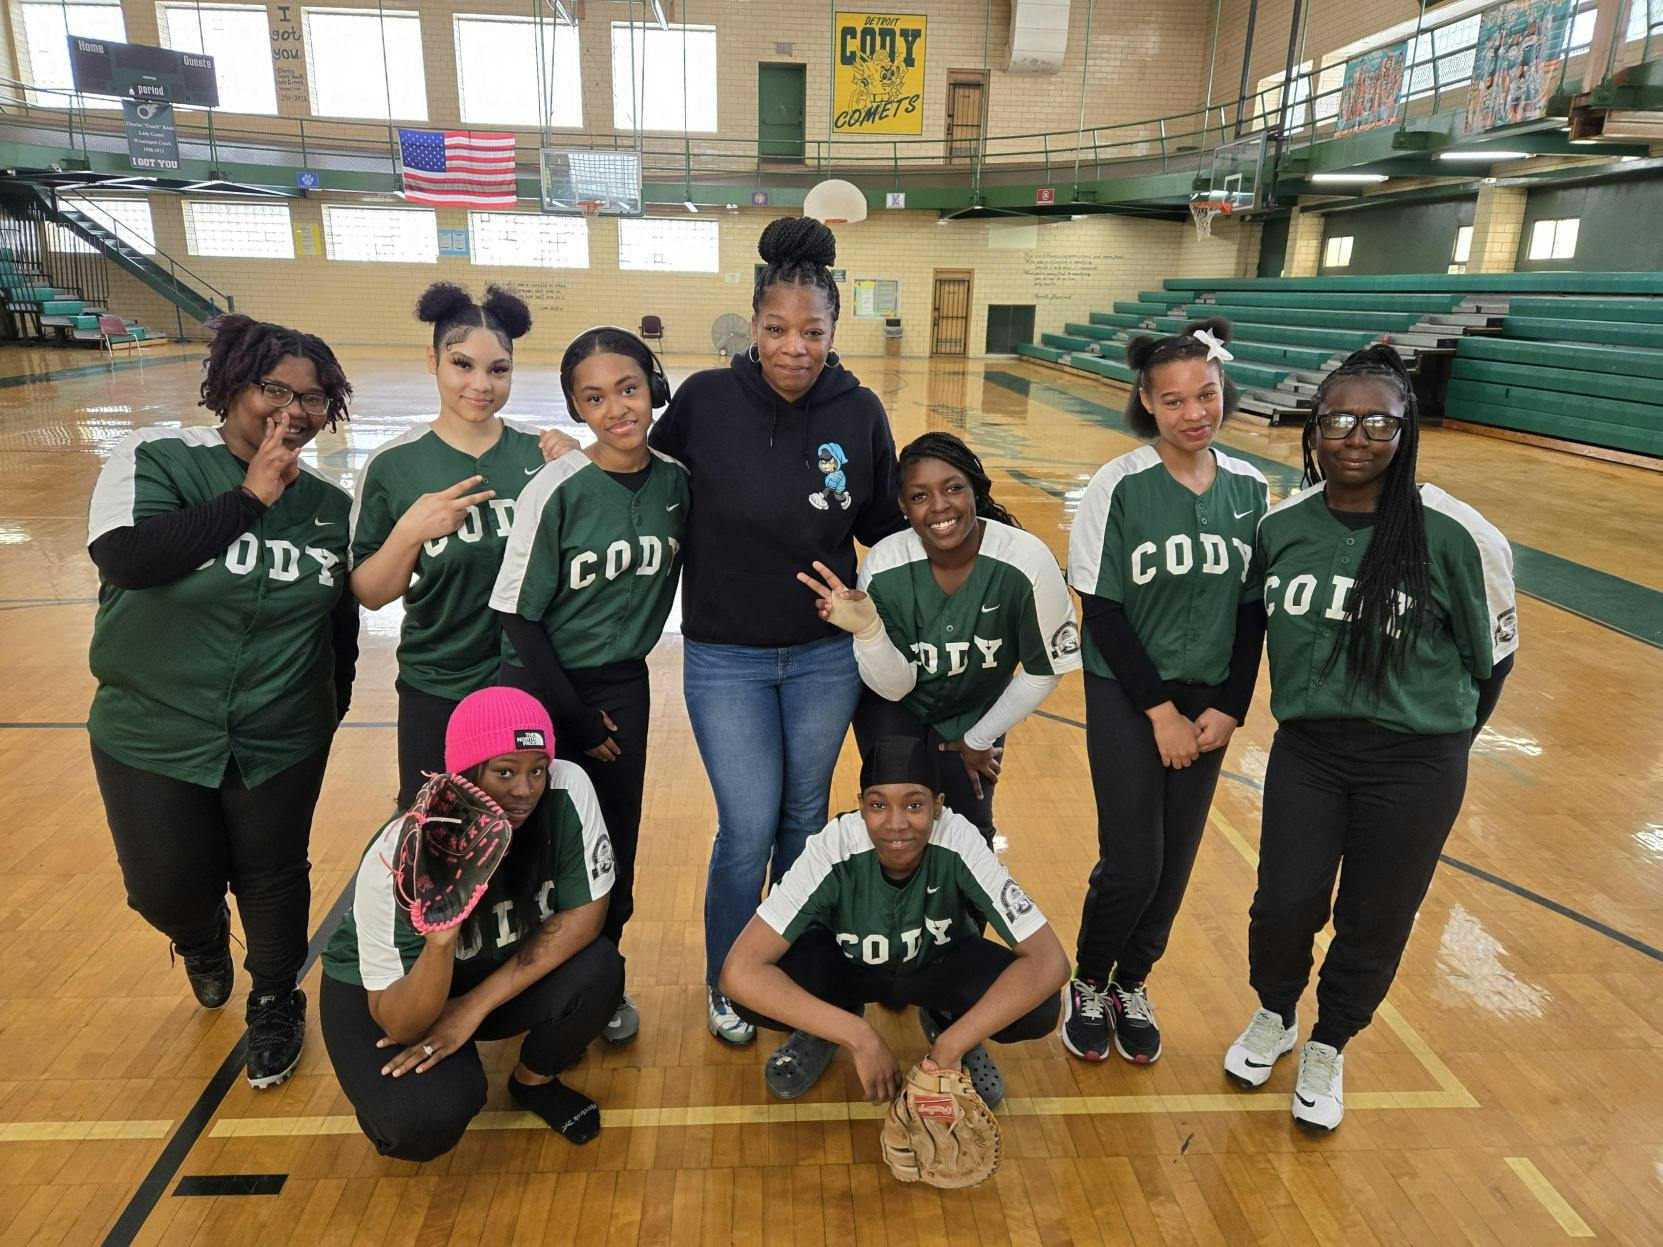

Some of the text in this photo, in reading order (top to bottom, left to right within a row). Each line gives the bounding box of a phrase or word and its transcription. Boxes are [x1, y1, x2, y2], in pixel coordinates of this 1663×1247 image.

[277, 6, 290, 22] I
[865, 16, 901, 26] DETROIT
[271, 26, 301, 41] got
[77, 40, 104, 54] Home
[841, 26, 921, 67] CODY
[183, 55, 212, 69] Guests
[137, 85, 164, 96] period
[835, 94, 920, 128] COMETS
[132, 157, 178, 169] I GOT YOU
[195, 532, 340, 587] ODY
[1131, 533, 1253, 585] CODY
